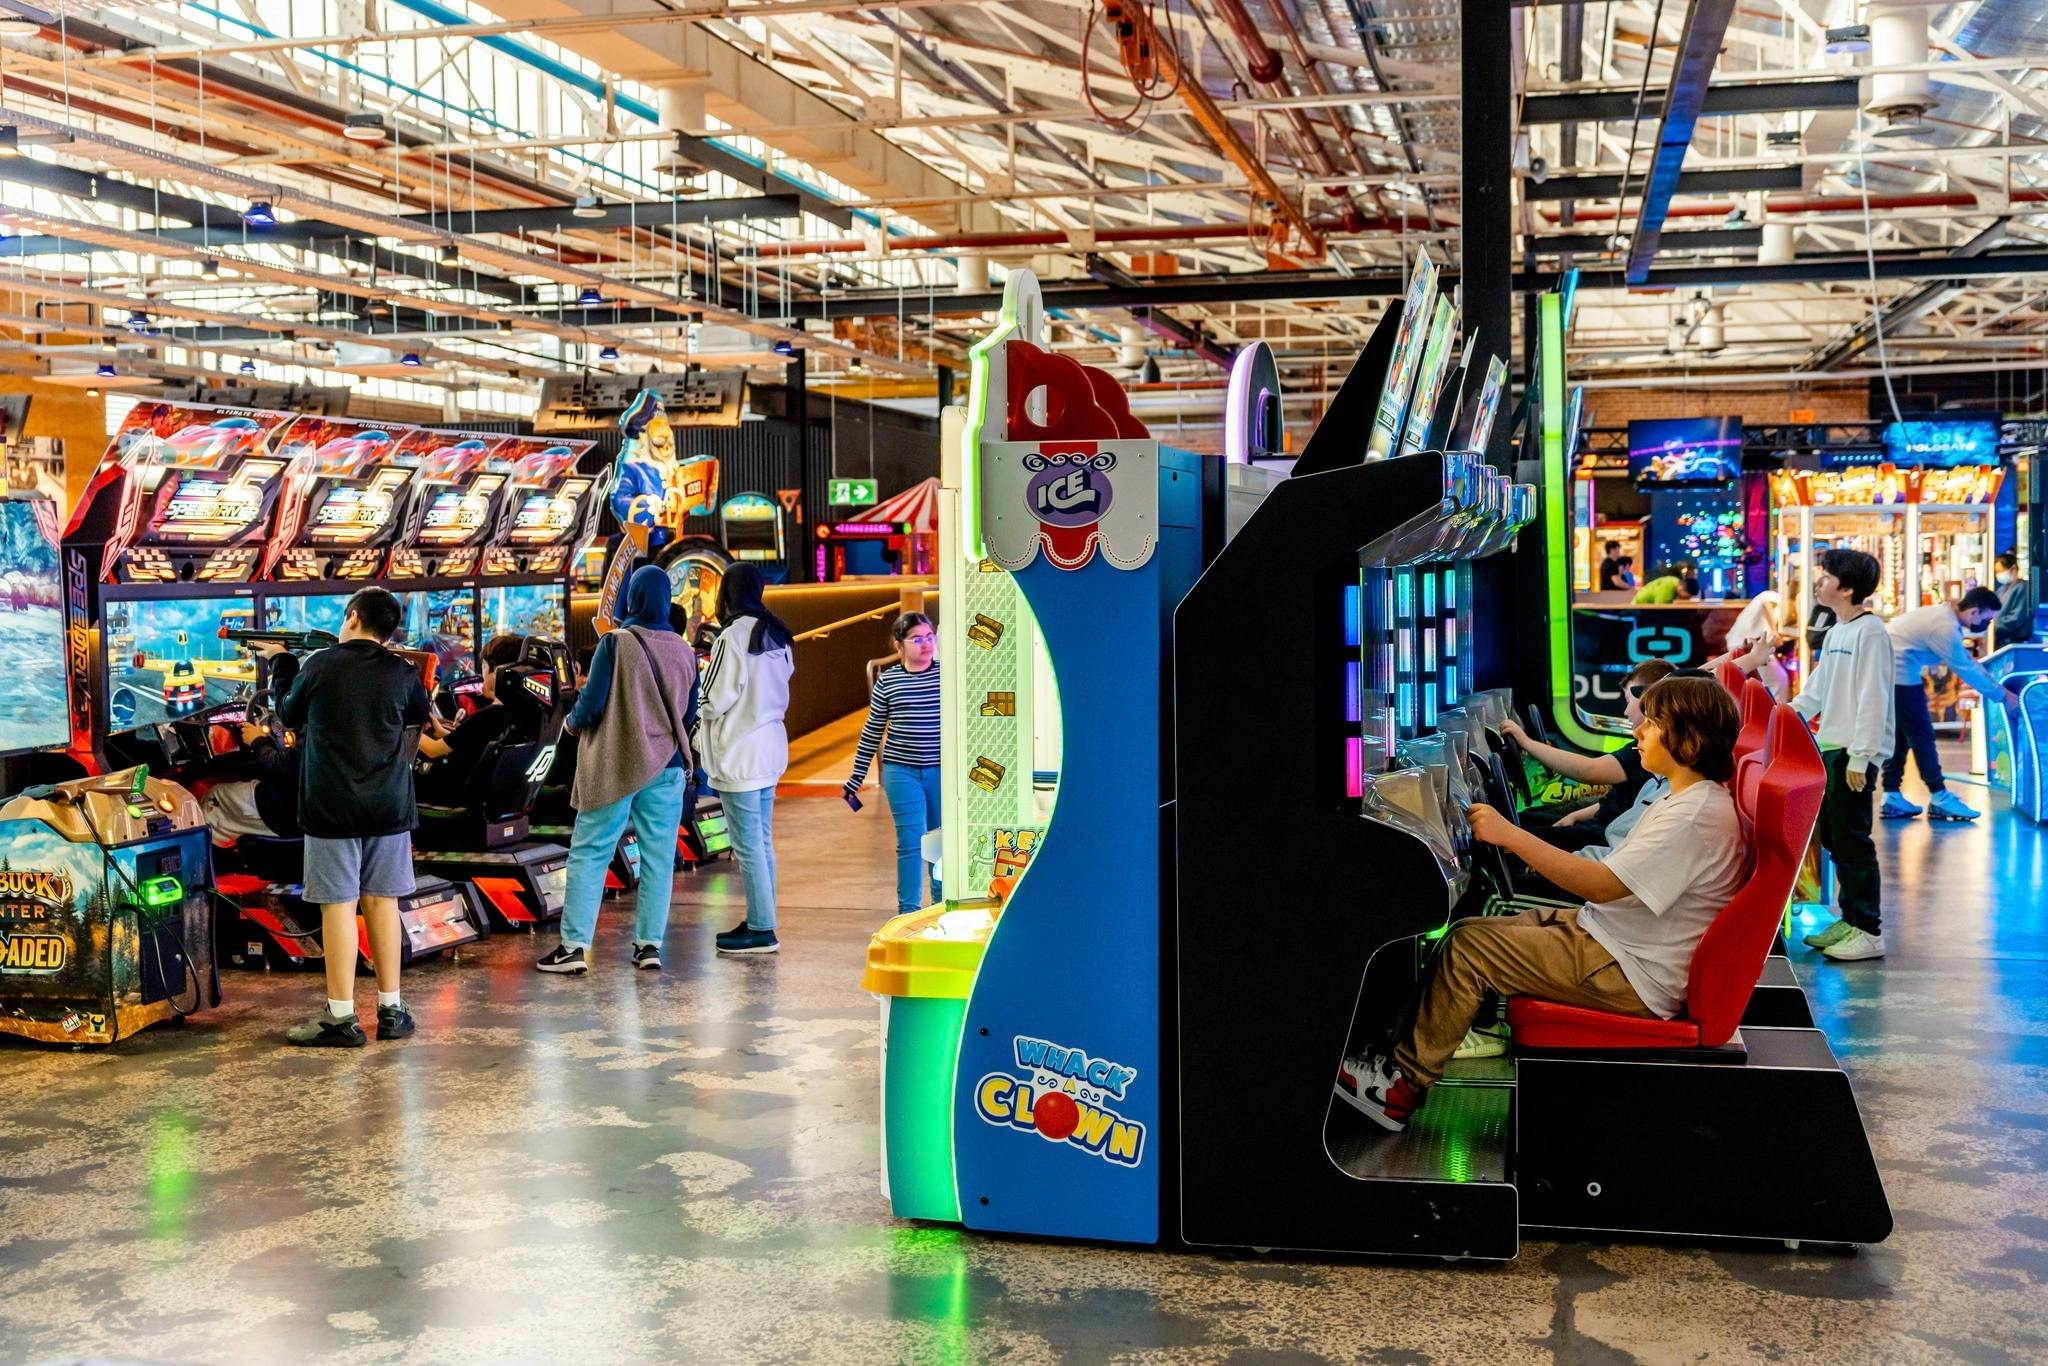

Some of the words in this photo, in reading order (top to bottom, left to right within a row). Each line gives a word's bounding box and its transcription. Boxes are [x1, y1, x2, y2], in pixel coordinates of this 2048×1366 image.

[1037, 468, 1098, 513] ICE
[0, 872, 62, 905] BUCK
[1016, 1038, 1131, 1098] WHACK
[1062, 1078, 1077, 1094] A
[979, 1076, 1141, 1161] CLOWN
